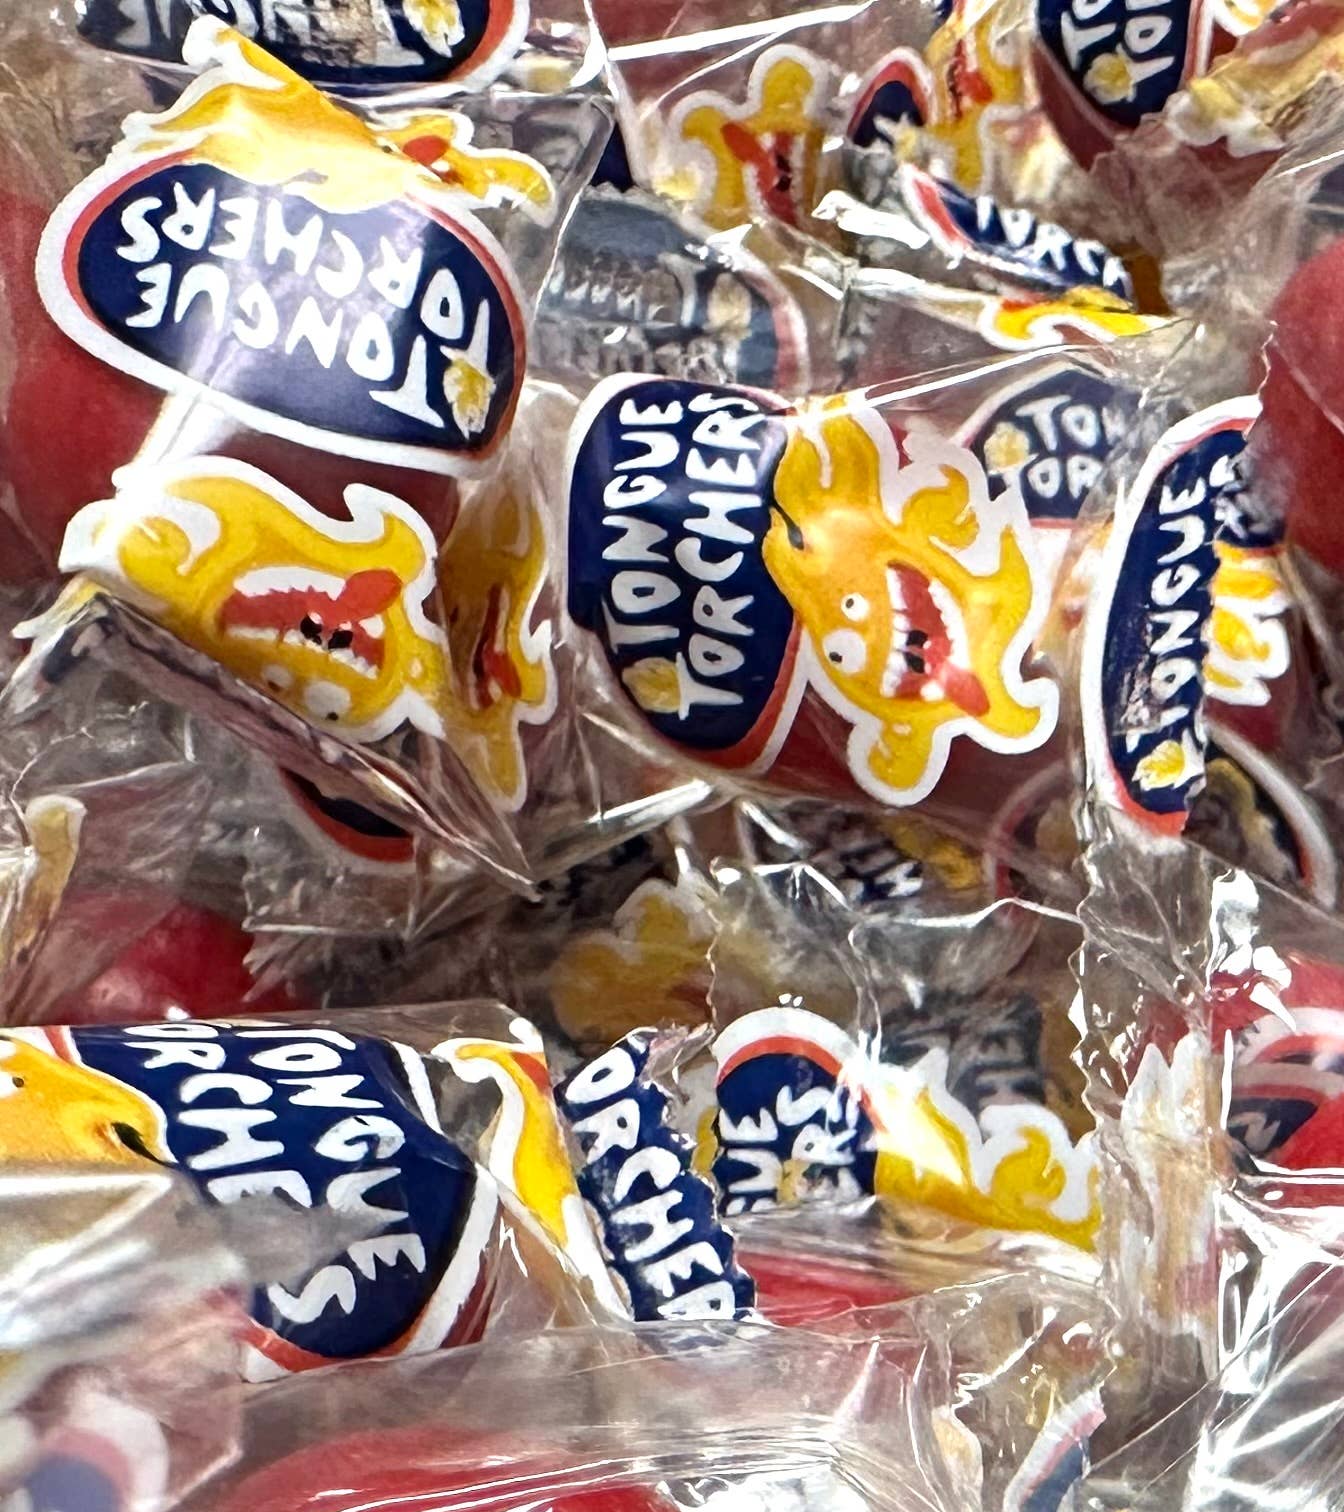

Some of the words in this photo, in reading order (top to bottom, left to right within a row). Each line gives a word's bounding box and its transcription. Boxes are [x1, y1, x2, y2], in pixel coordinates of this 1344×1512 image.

[117, 180, 497, 430] TORCHERS
[126, 262, 445, 428] TONGUE
[601, 399, 685, 653] TONGUE
[650, 392, 761, 720] TORCHERS
[1122, 480, 1207, 758] TONGUE
[124, 1022, 357, 1325] ORCHES
[237, 1027, 427, 1279] TONGUE
